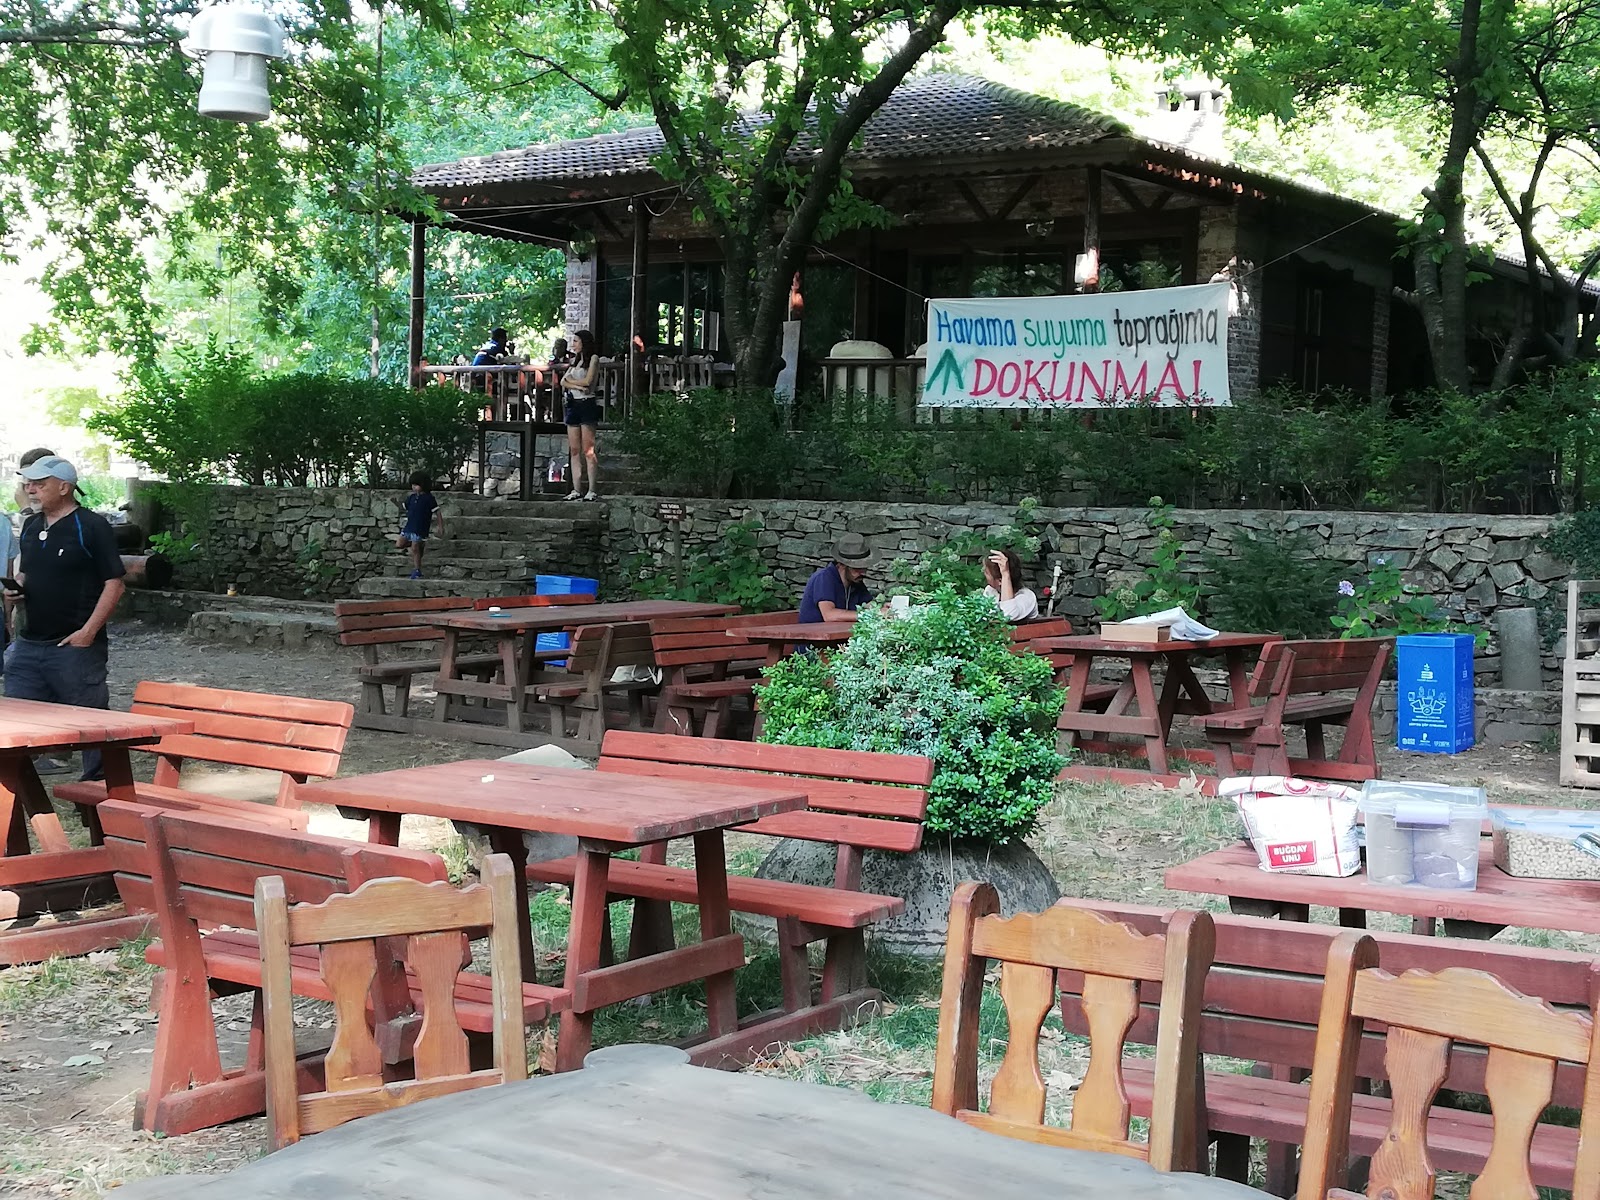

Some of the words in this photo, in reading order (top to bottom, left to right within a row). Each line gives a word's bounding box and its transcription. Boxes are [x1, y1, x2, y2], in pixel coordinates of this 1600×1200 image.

[936, 309, 1017, 347] Havama
[1023, 316, 1107, 359] suyuma
[1113, 308, 1219, 361] toprağıma
[1273, 844, 1308, 855] BUĞDAY
[1281, 854, 1301, 863] UNU
